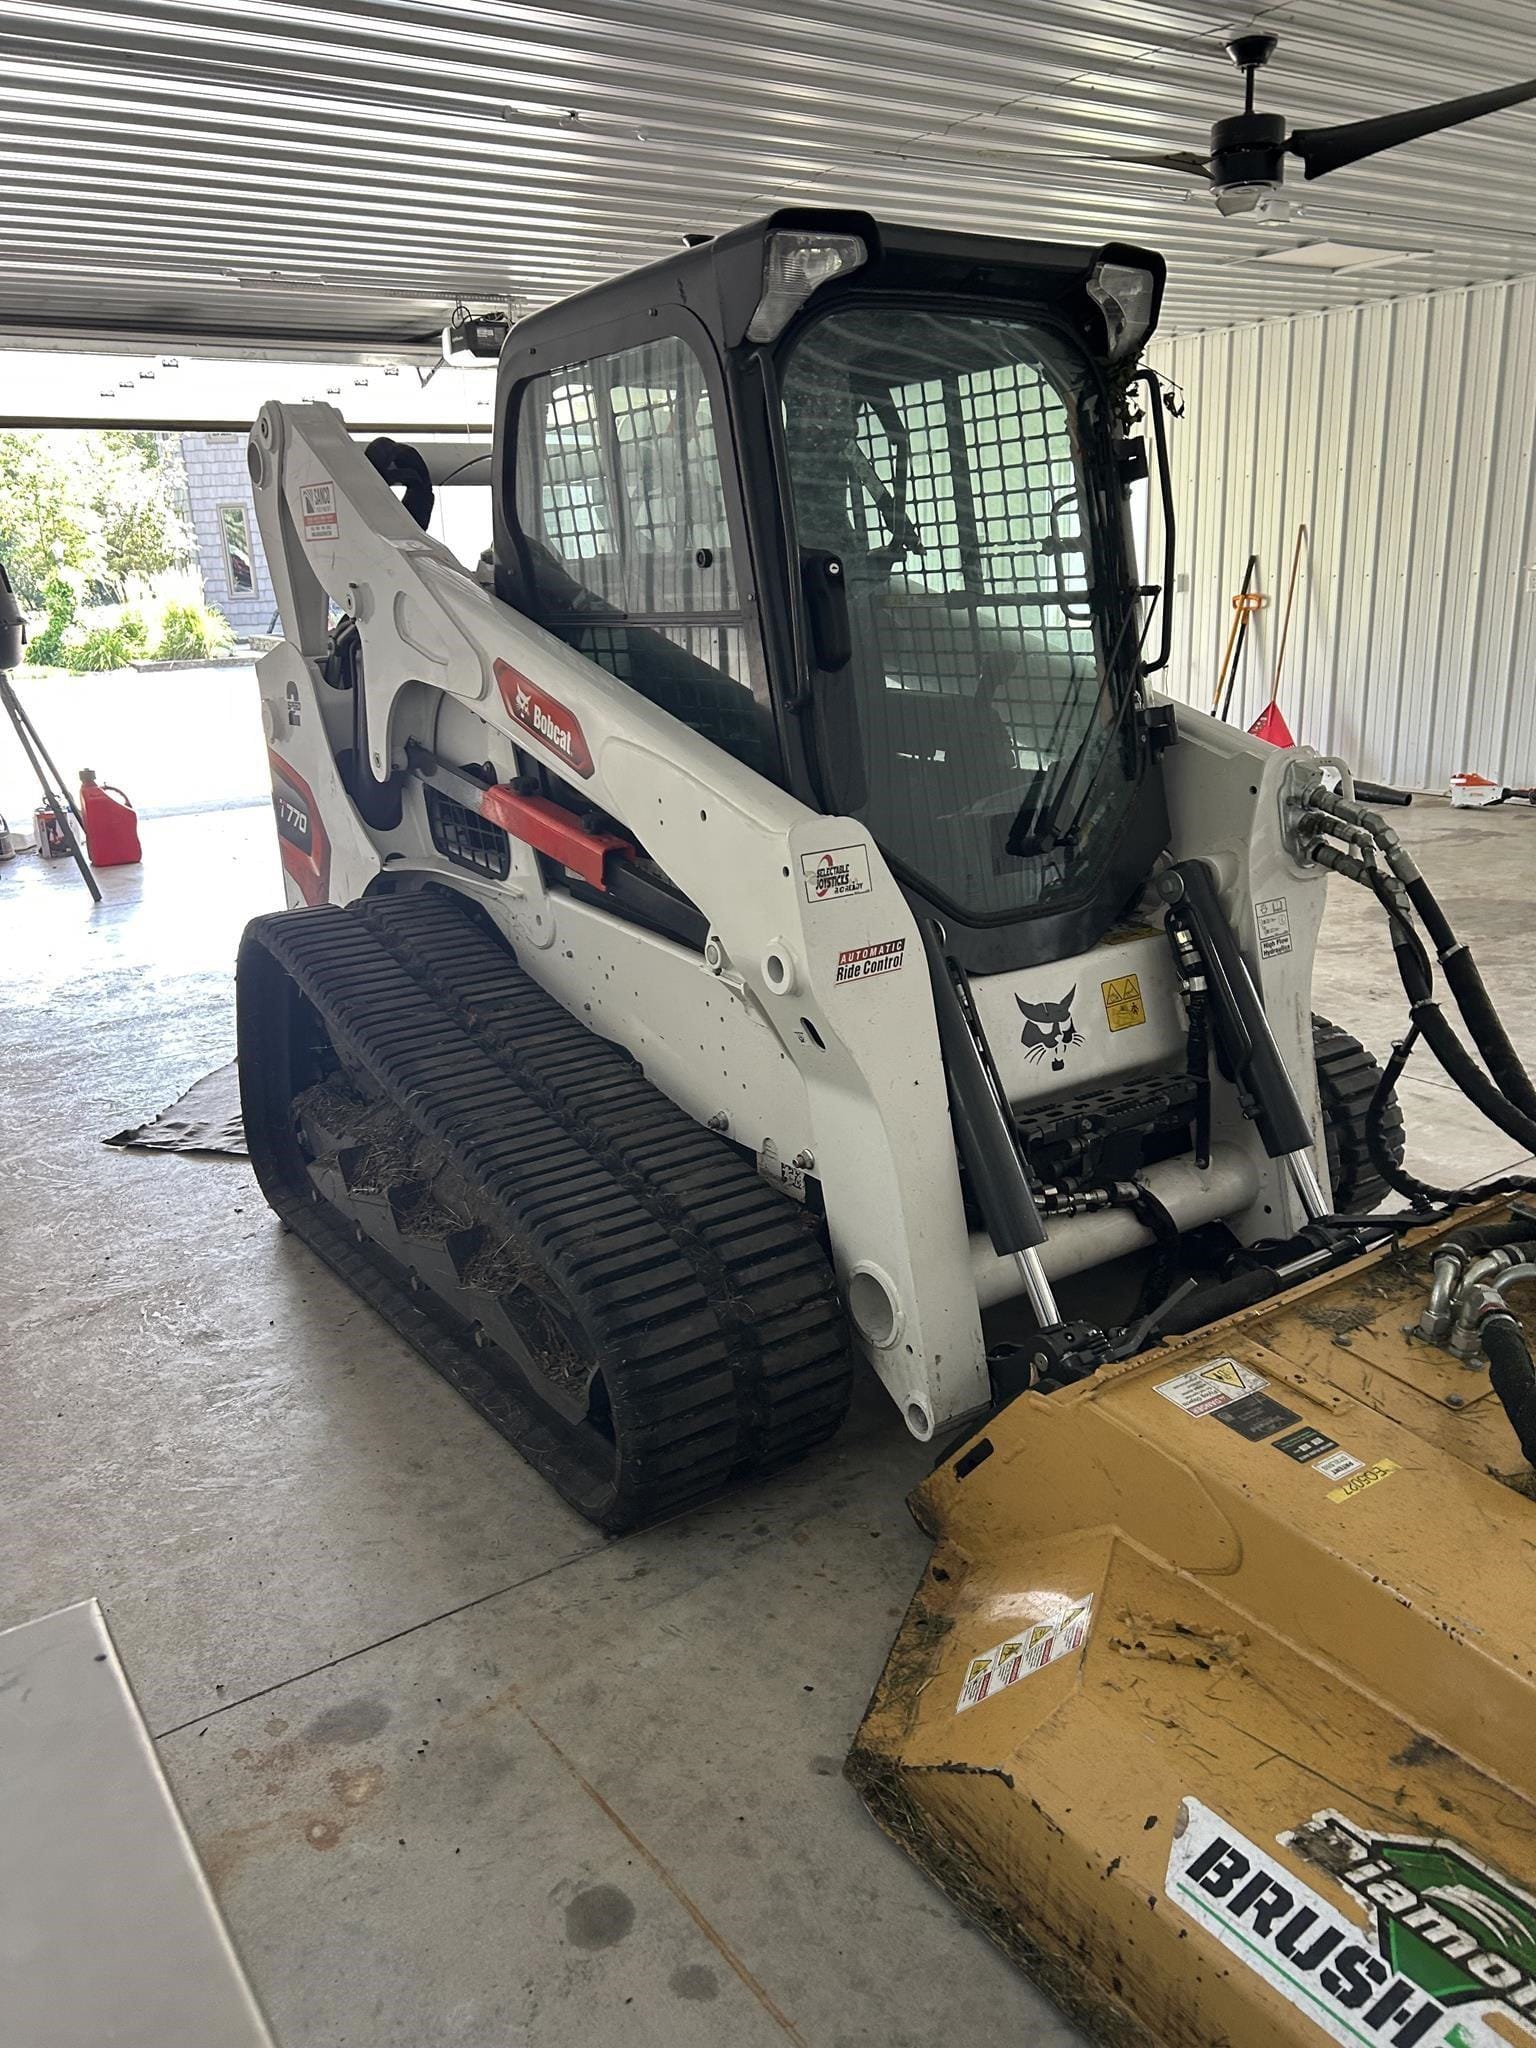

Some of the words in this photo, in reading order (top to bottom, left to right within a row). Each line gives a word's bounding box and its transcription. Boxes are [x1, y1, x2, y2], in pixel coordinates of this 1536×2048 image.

[533, 704, 572, 755] Bobcat
[815, 873, 849, 891] JOYSTICKS
[816, 864, 850, 879] SELECTABLE
[840, 940, 903, 964] AUTOMATIC
[836, 963, 861, 982] Ride
[863, 952, 904, 975] Control
[1192, 1397, 1223, 1414] DANGER
[1185, 1836, 1445, 2048] BRUSH
